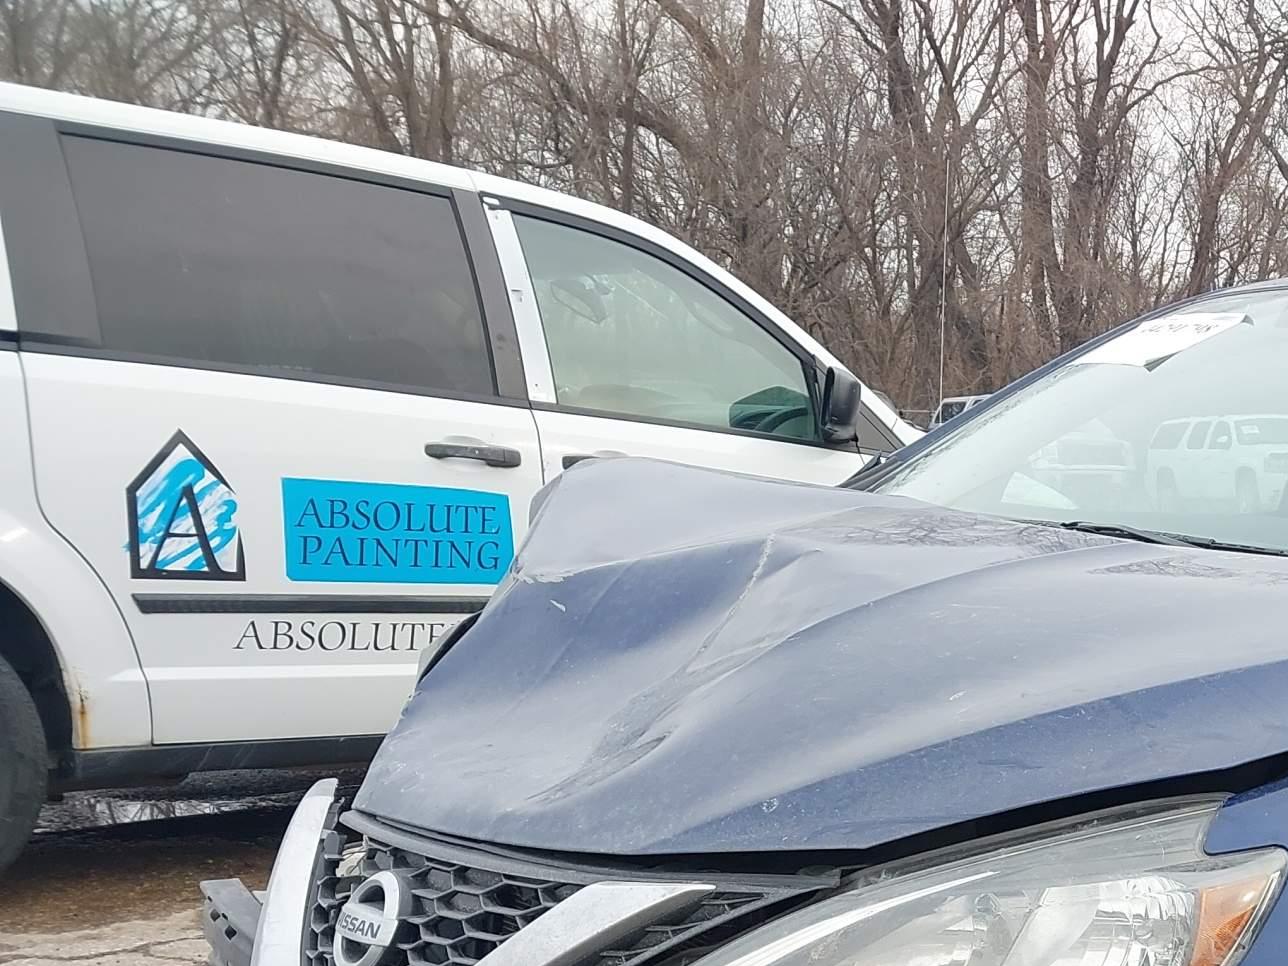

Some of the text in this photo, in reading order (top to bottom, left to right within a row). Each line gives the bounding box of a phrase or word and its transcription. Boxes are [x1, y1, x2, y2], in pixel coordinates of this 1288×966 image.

[294, 496, 500, 535] ABSOLUTE
[299, 535, 500, 570] PAINTING
[232, 619, 456, 651] ABSOLUTE
